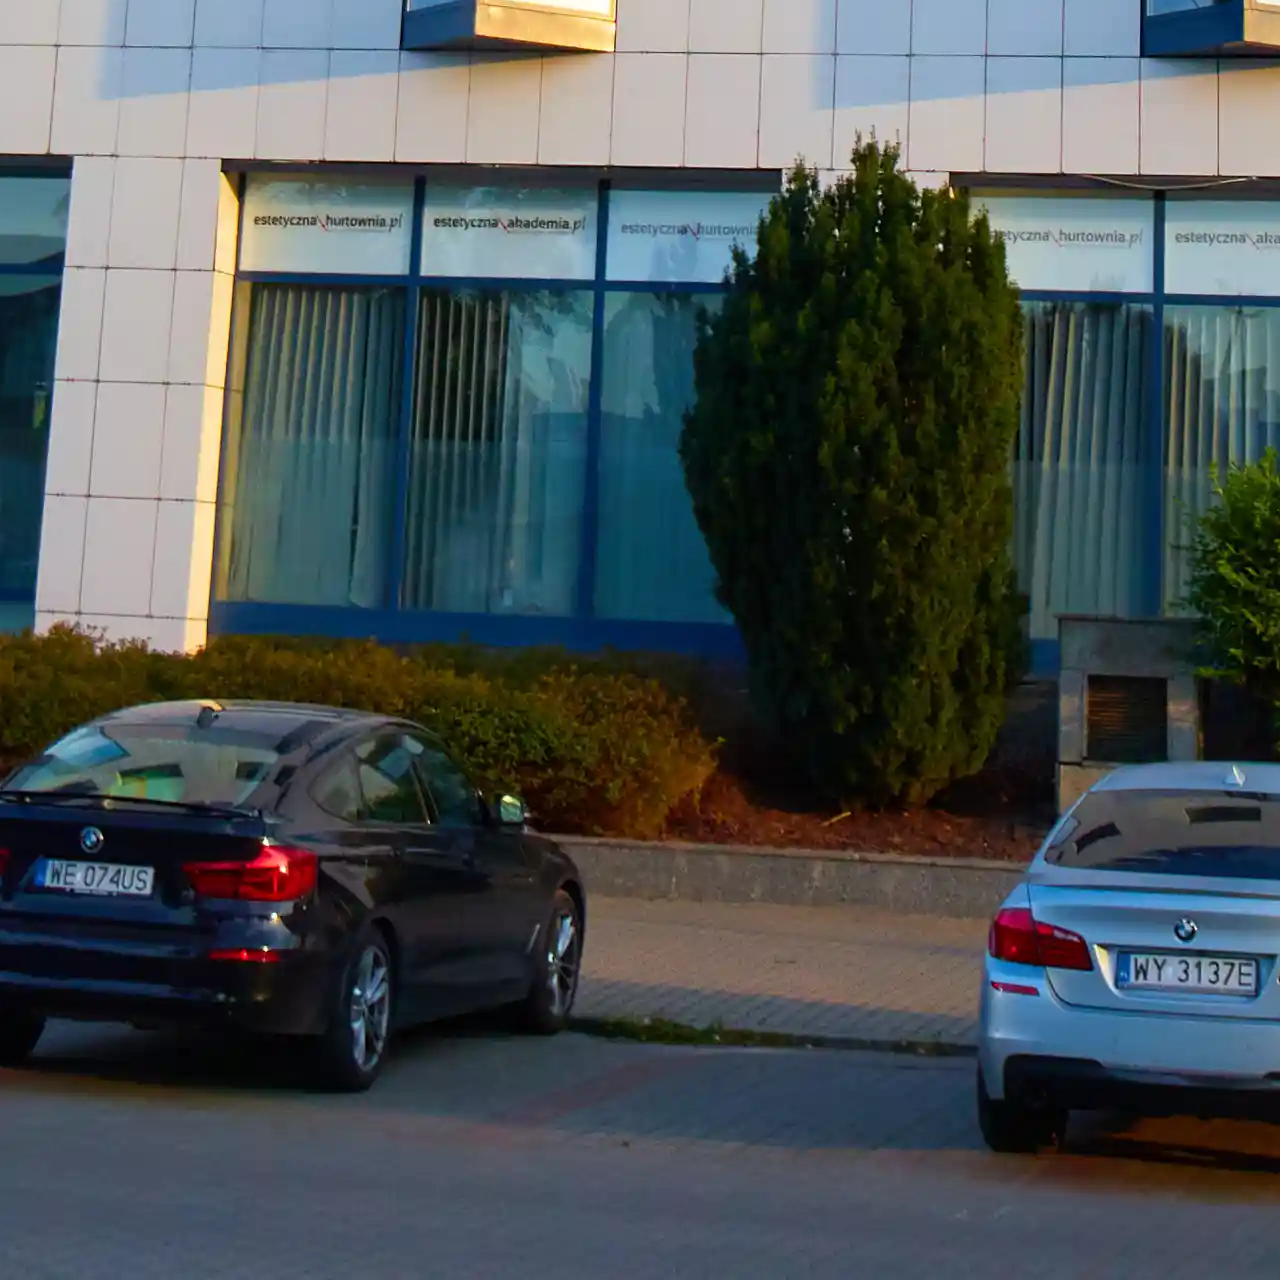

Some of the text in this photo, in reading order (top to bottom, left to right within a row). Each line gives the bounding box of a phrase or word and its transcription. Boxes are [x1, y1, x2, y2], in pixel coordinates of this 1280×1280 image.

[50, 862, 149, 892] WE 074US
[1133, 956, 1253, 987] WY 3137E
